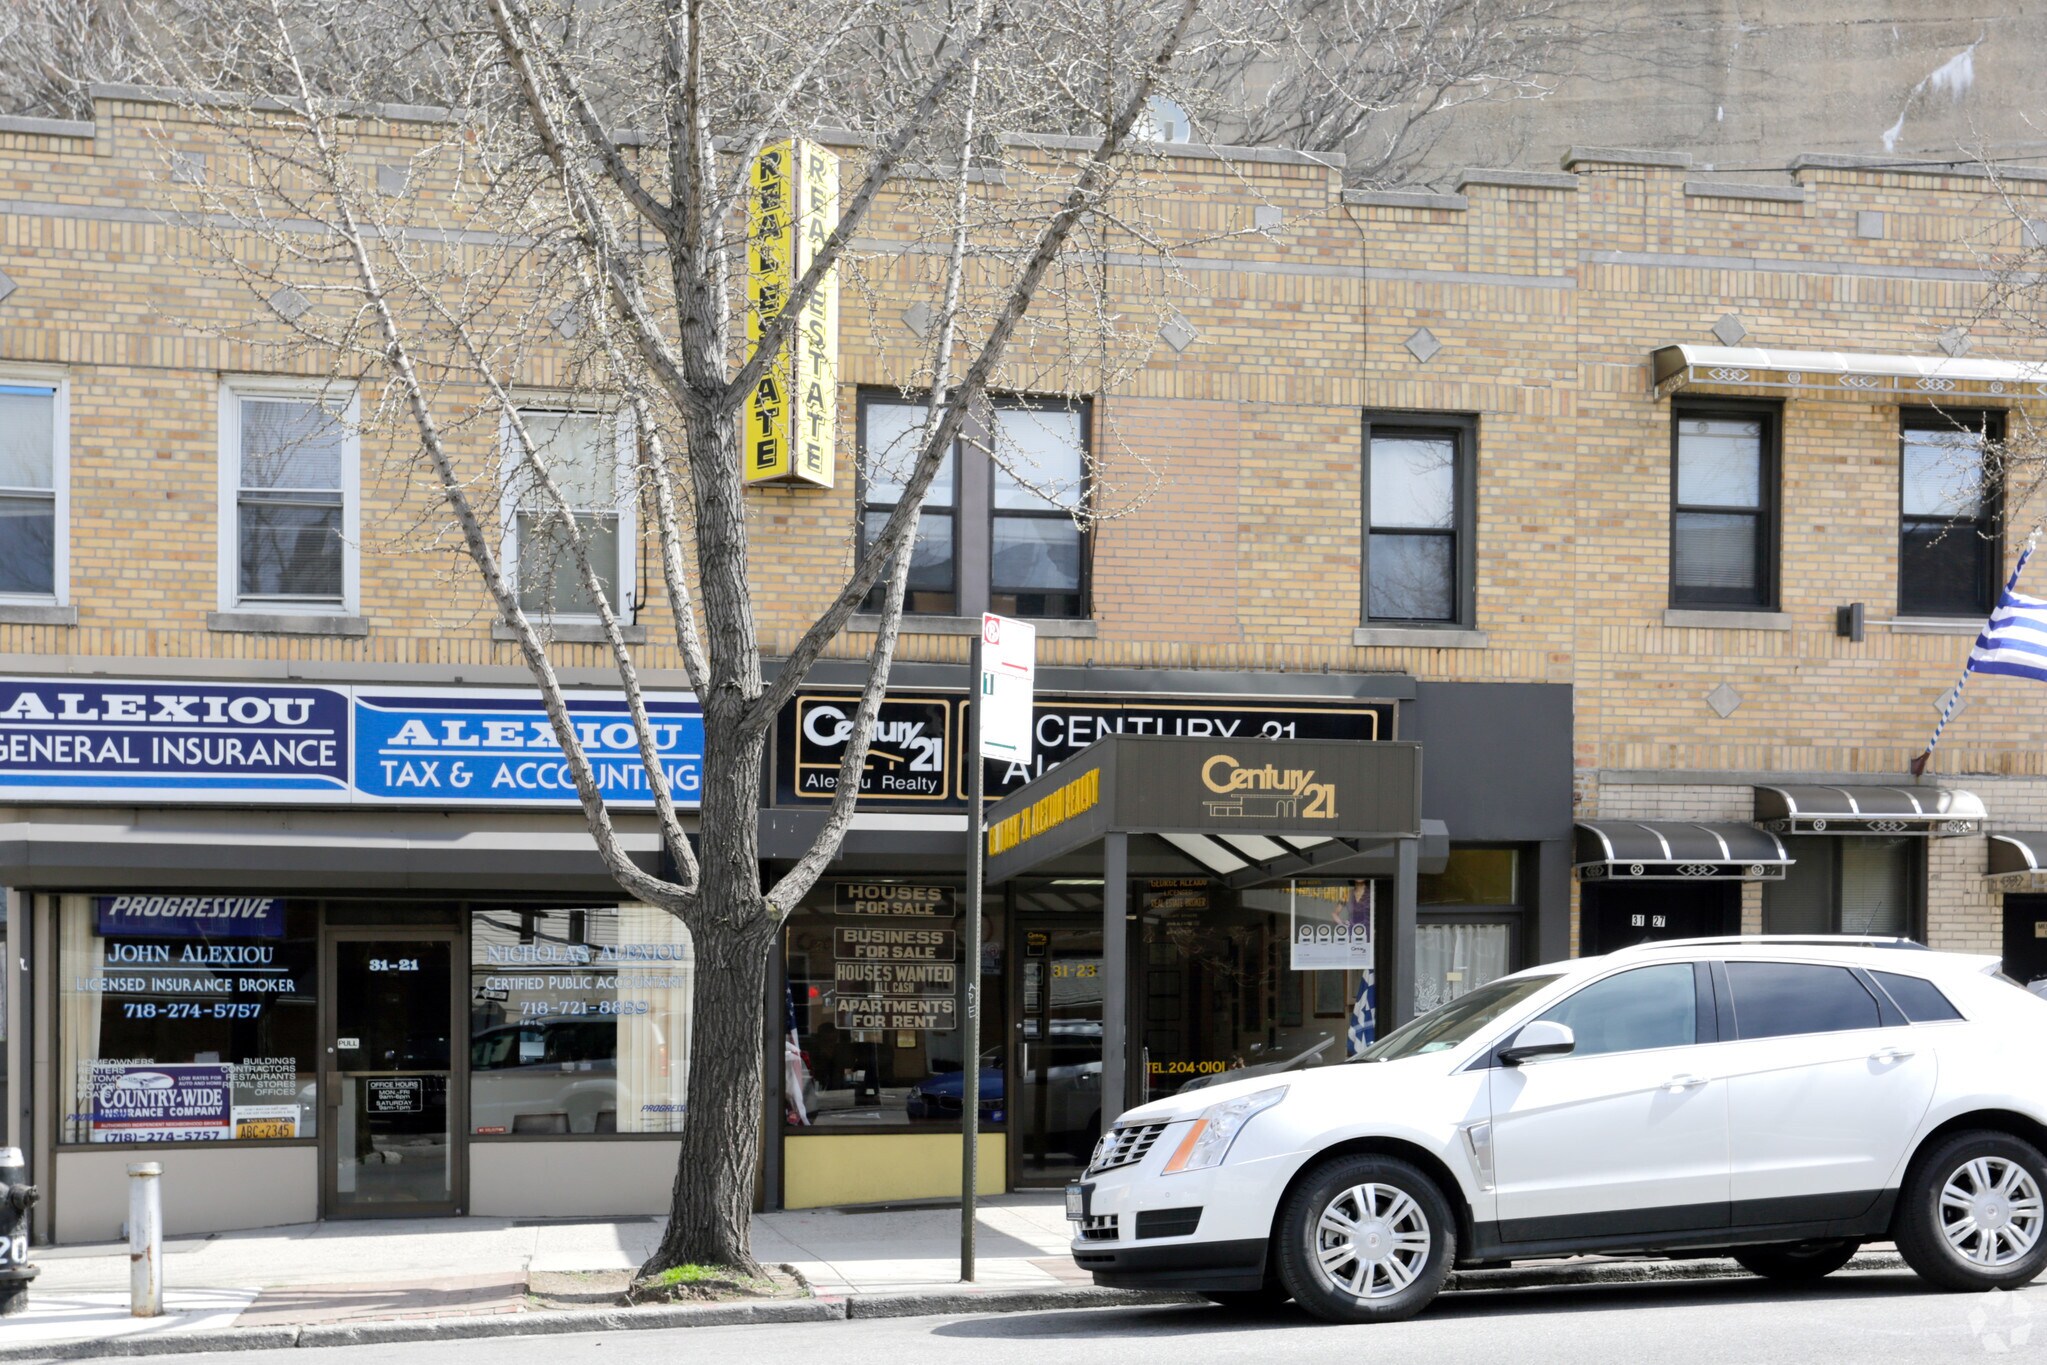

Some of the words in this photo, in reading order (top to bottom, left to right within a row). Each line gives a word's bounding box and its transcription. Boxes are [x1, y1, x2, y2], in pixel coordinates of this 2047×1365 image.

[808, 154, 826, 262] REA
[0, 692, 315, 725] ALEXIOU
[387, 719, 682, 750] ALEXIOU
[152, 737, 336, 766] INSURANCE
[909, 736, 942, 772] 21
[380, 760, 441, 787] TAX
[450, 761, 473, 788] &
[882, 775, 938, 794] Realty
[1201, 754, 1315, 796] Century
[1302, 783, 1335, 818] 21
[848, 885, 942, 900] HOUSES
[109, 896, 274, 918] PROGRESSIVE
[855, 901, 889, 914] FOR
[892, 902, 935, 915] SALE
[1633, 915, 1644, 925] 31
[1653, 916, 1665, 927] 27
[843, 929, 944, 945] BUSINESS
[108, 943, 170, 963] JOHN
[179, 944, 274, 964] ALEXIOU
[486, 945, 591, 963] NICHOLAS
[599, 944, 686, 962] ALEXIOU
[855, 945, 889, 958] FOR
[892, 946, 936, 959] SALE
[369, 959, 419, 971] 31-21
[1052, 964, 1097, 977] 31-23
[837, 964, 892, 981] HOUSES
[895, 965, 954, 983] WANTED
[76, 976, 146, 992] LICENSED
[152, 977, 232, 992] INSURANCE
[239, 978, 295, 993] BROKER
[485, 976, 544, 990] CERTIFIED
[549, 976, 592, 990] PUBLIC
[596, 976, 684, 990] ACCOUNTANT
[874, 982, 890, 993] ALL
[892, 982, 914, 993] CASH
[124, 1003, 261, 1018] 718-274-5757
[520, 1001, 649, 1015] 718-721-8859
[838, 999, 953, 1013] APARTMENTS
[852, 1014, 886, 1027] FOR
[892, 1015, 937, 1028] RENT
[243, 1057, 296, 1065] BUILDINGS
[220, 1065, 296, 1073] CONTRACTORS
[257, 1080, 296, 1088] STORES
[100, 1087, 223, 1108] COUNTRY-WIDE
[254, 1088, 296, 1096] OFFICES
[101, 1108, 164, 1118] INSURANCE
[169, 1106, 223, 1117] COMPANY
[105, 1131, 219, 1141] (718)-274-5757
